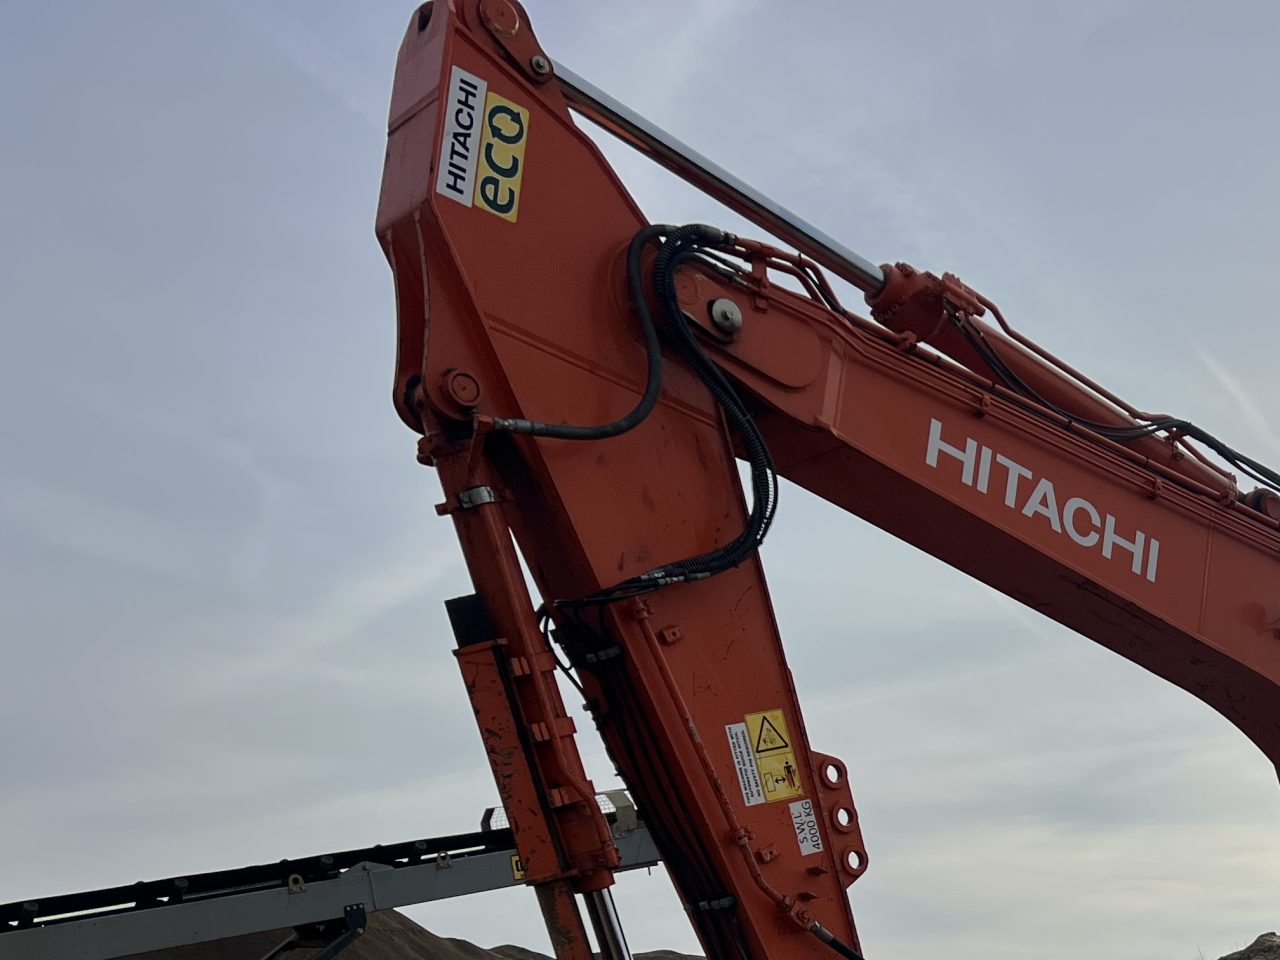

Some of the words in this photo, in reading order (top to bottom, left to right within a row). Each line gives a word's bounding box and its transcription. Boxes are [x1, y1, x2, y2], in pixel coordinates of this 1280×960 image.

[446, 78, 478, 195] HITACHI
[480, 104, 525, 215] eco
[924, 417, 1160, 584] HITACHI
[739, 767, 747, 791] MACHINE
[744, 768, 754, 798] AUTOMATIC
[751, 768, 759, 788] SAFETY
[802, 801, 812, 817] KG
[806, 820, 820, 850] 4000
